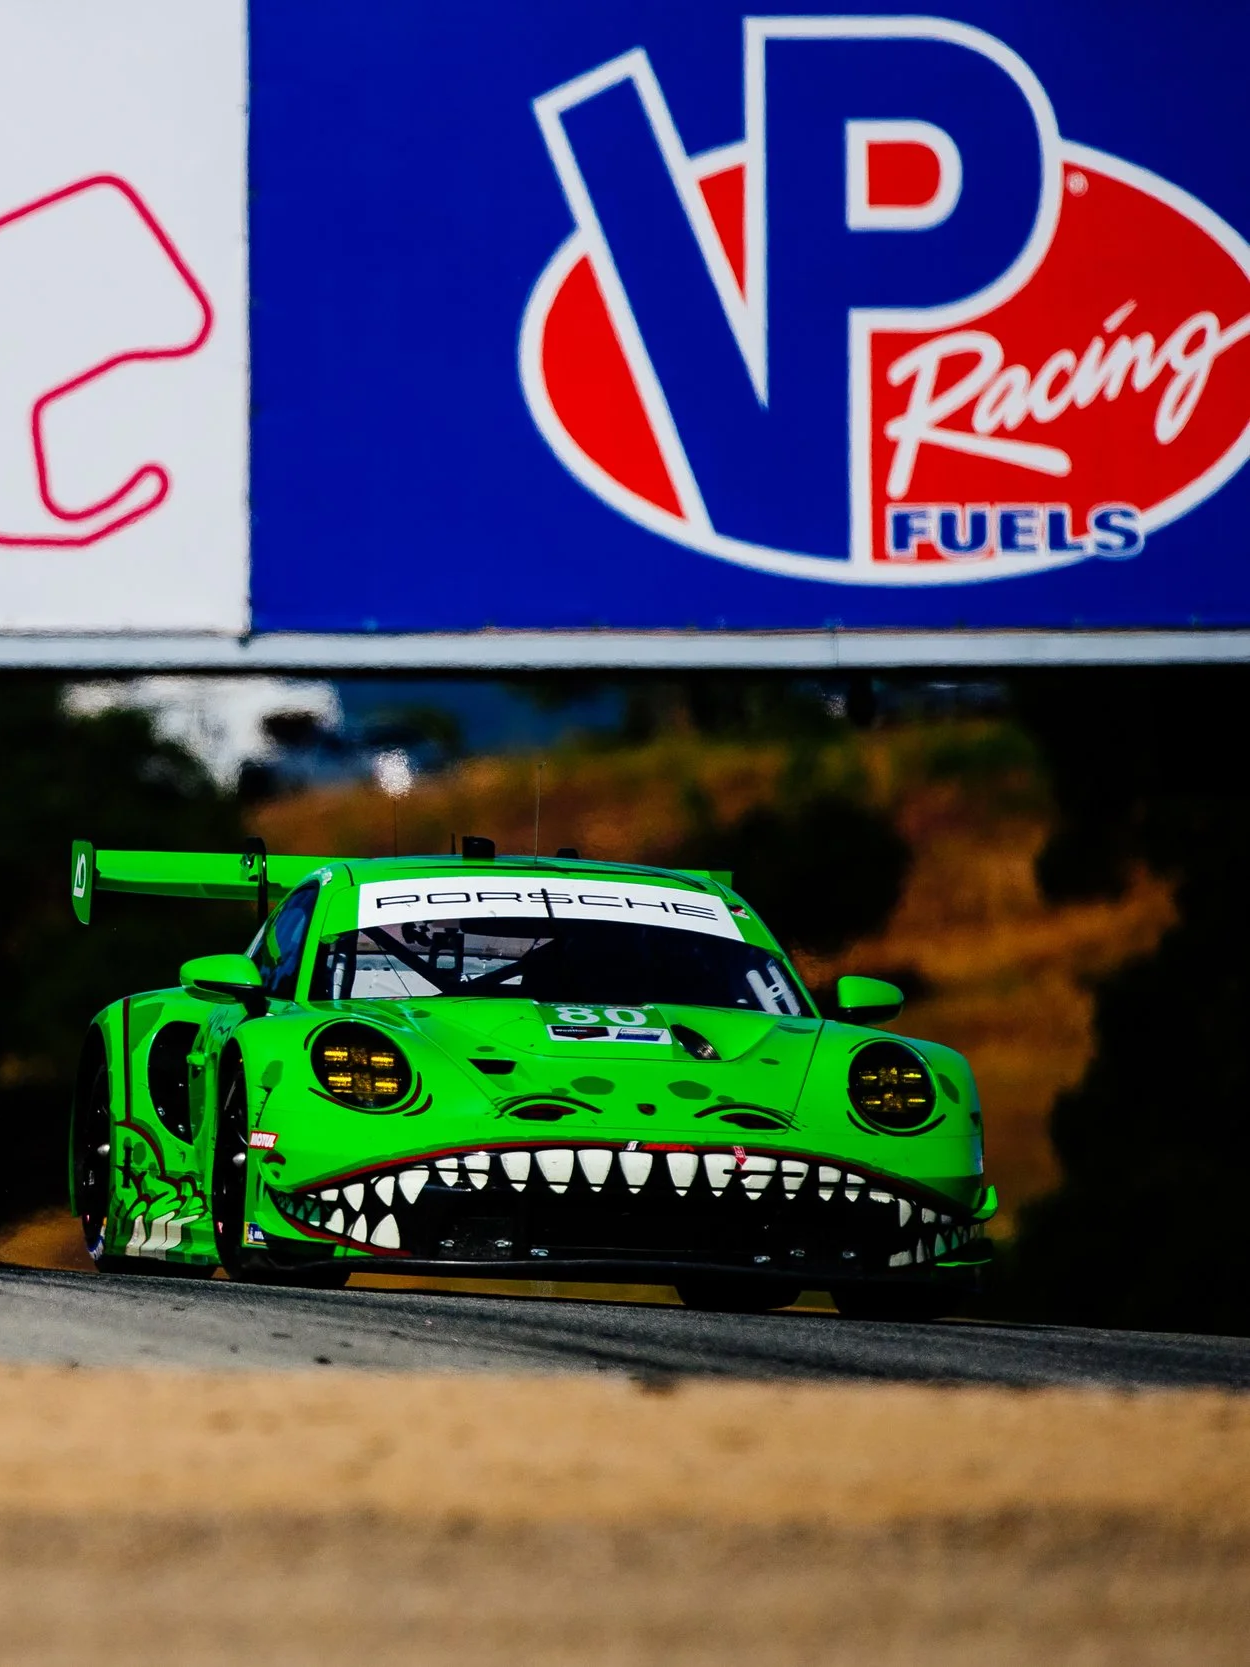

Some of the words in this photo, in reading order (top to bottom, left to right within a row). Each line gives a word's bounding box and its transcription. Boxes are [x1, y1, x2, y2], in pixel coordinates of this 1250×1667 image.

[533, 14, 1062, 566] VP
[883, 299, 1242, 501] Racing
[886, 502, 1147, 561] FUELS
[375, 888, 719, 921] PORSCHE
[554, 1006, 648, 1026] 80
[250, 1132, 277, 1149] MOTUL
